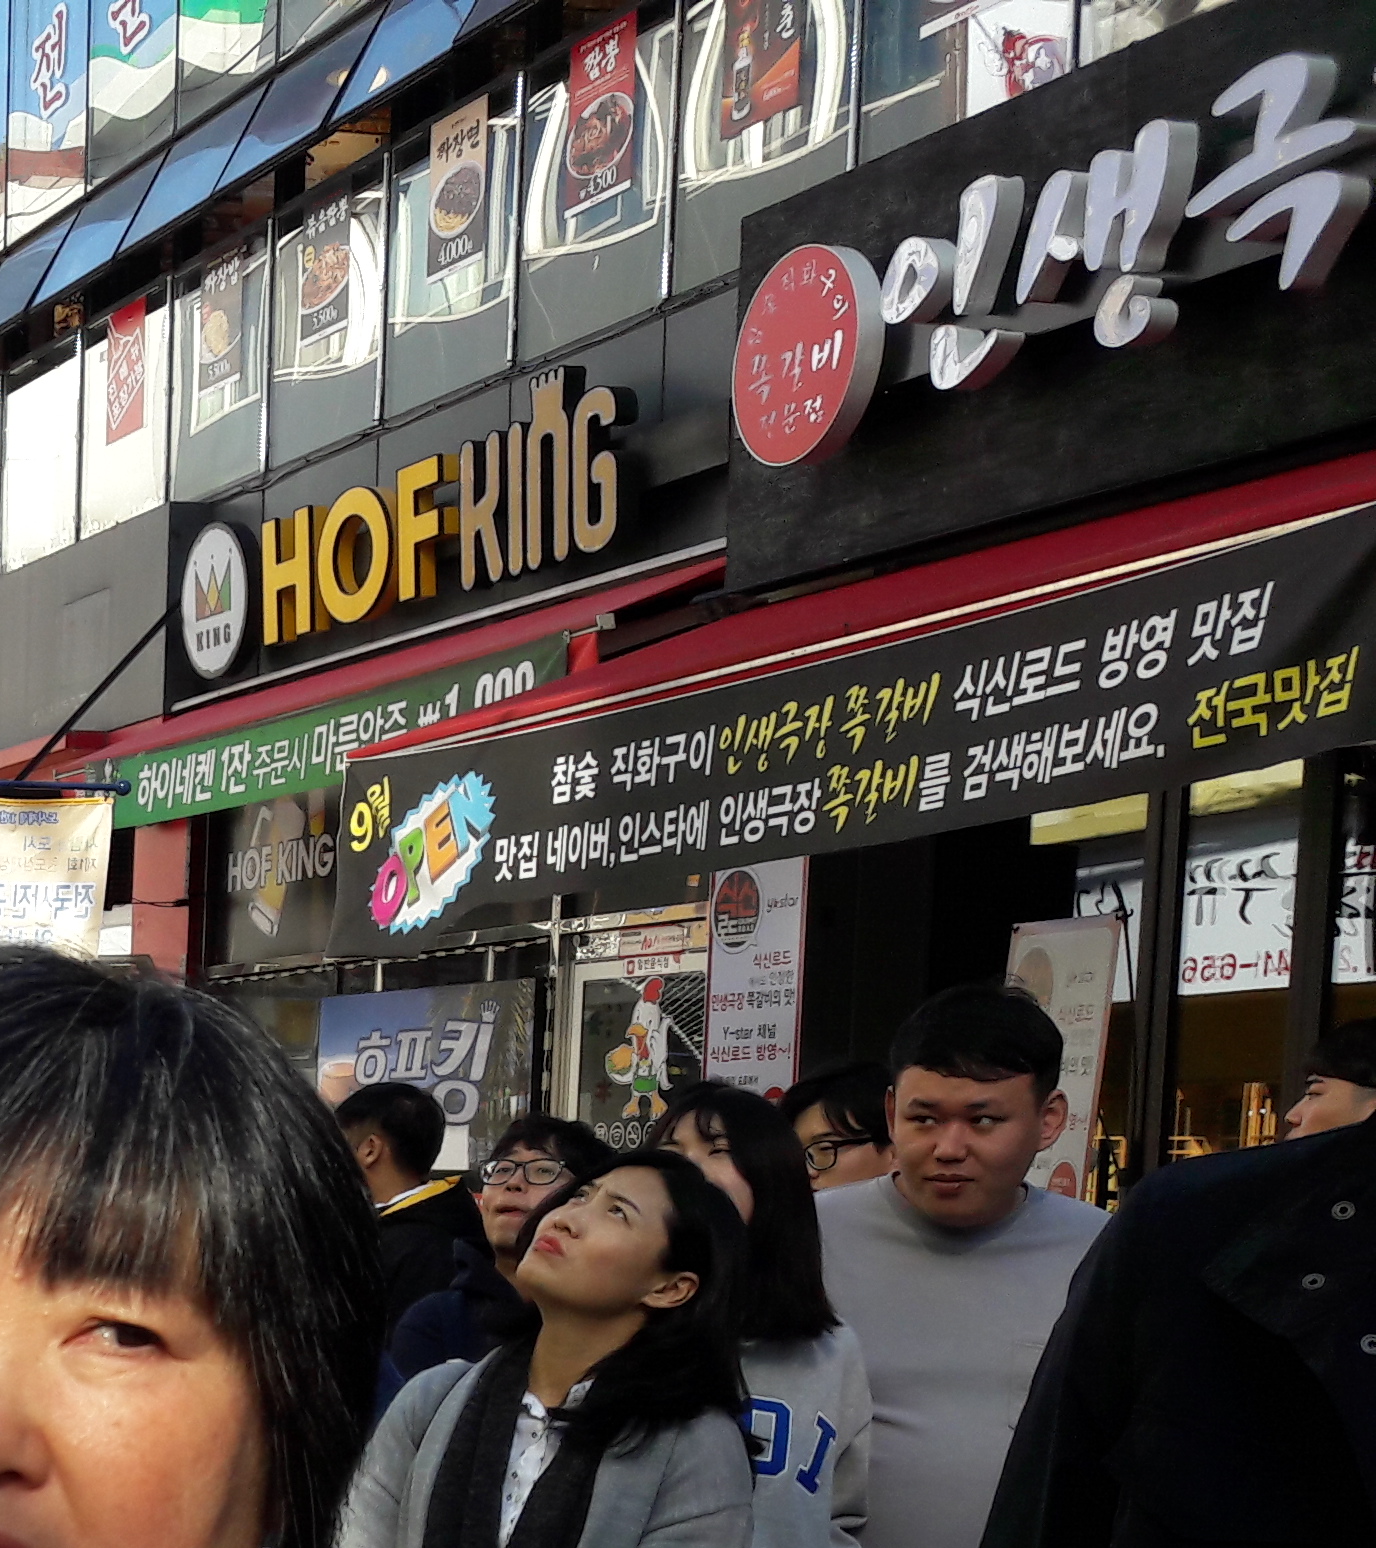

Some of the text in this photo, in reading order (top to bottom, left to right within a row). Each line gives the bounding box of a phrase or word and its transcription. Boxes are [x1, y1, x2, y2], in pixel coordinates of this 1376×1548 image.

[584, 35, 620, 81] 짬뽕
[436, 118, 480, 163] 짜장면
[262, 365, 620, 647] HOF KING
[196, 622, 233, 652] KING
[551, 752, 600, 806] 참숯
[610, 723, 716, 793] 직화구이
[718, 700, 835, 775] 인생극장
[952, 637, 1087, 724] 식신로드
[1097, 608, 1177, 689] 방영
[1186, 580, 1277, 669] 맛집
[137, 756, 216, 814] 하이네켄
[220, 740, 251, 793] 1잔
[252, 738, 308, 790] 주문시
[417, 659, 536, 728] ₩1000
[494, 834, 539, 885] 맛집
[718, 777, 822, 848] 인생극장
[962, 702, 1166, 802] 검색해보세요.
[1187, 645, 1361, 752] 전국맛집
[349, 775, 394, 852] 9월
[227, 832, 335, 893] HOF KING
[369, 772, 497, 928] OPEN
[753, 950, 793, 968] 식신로드
[710, 1045, 753, 1063] 식신로드
[723, 1026, 754, 1041] Y-star
